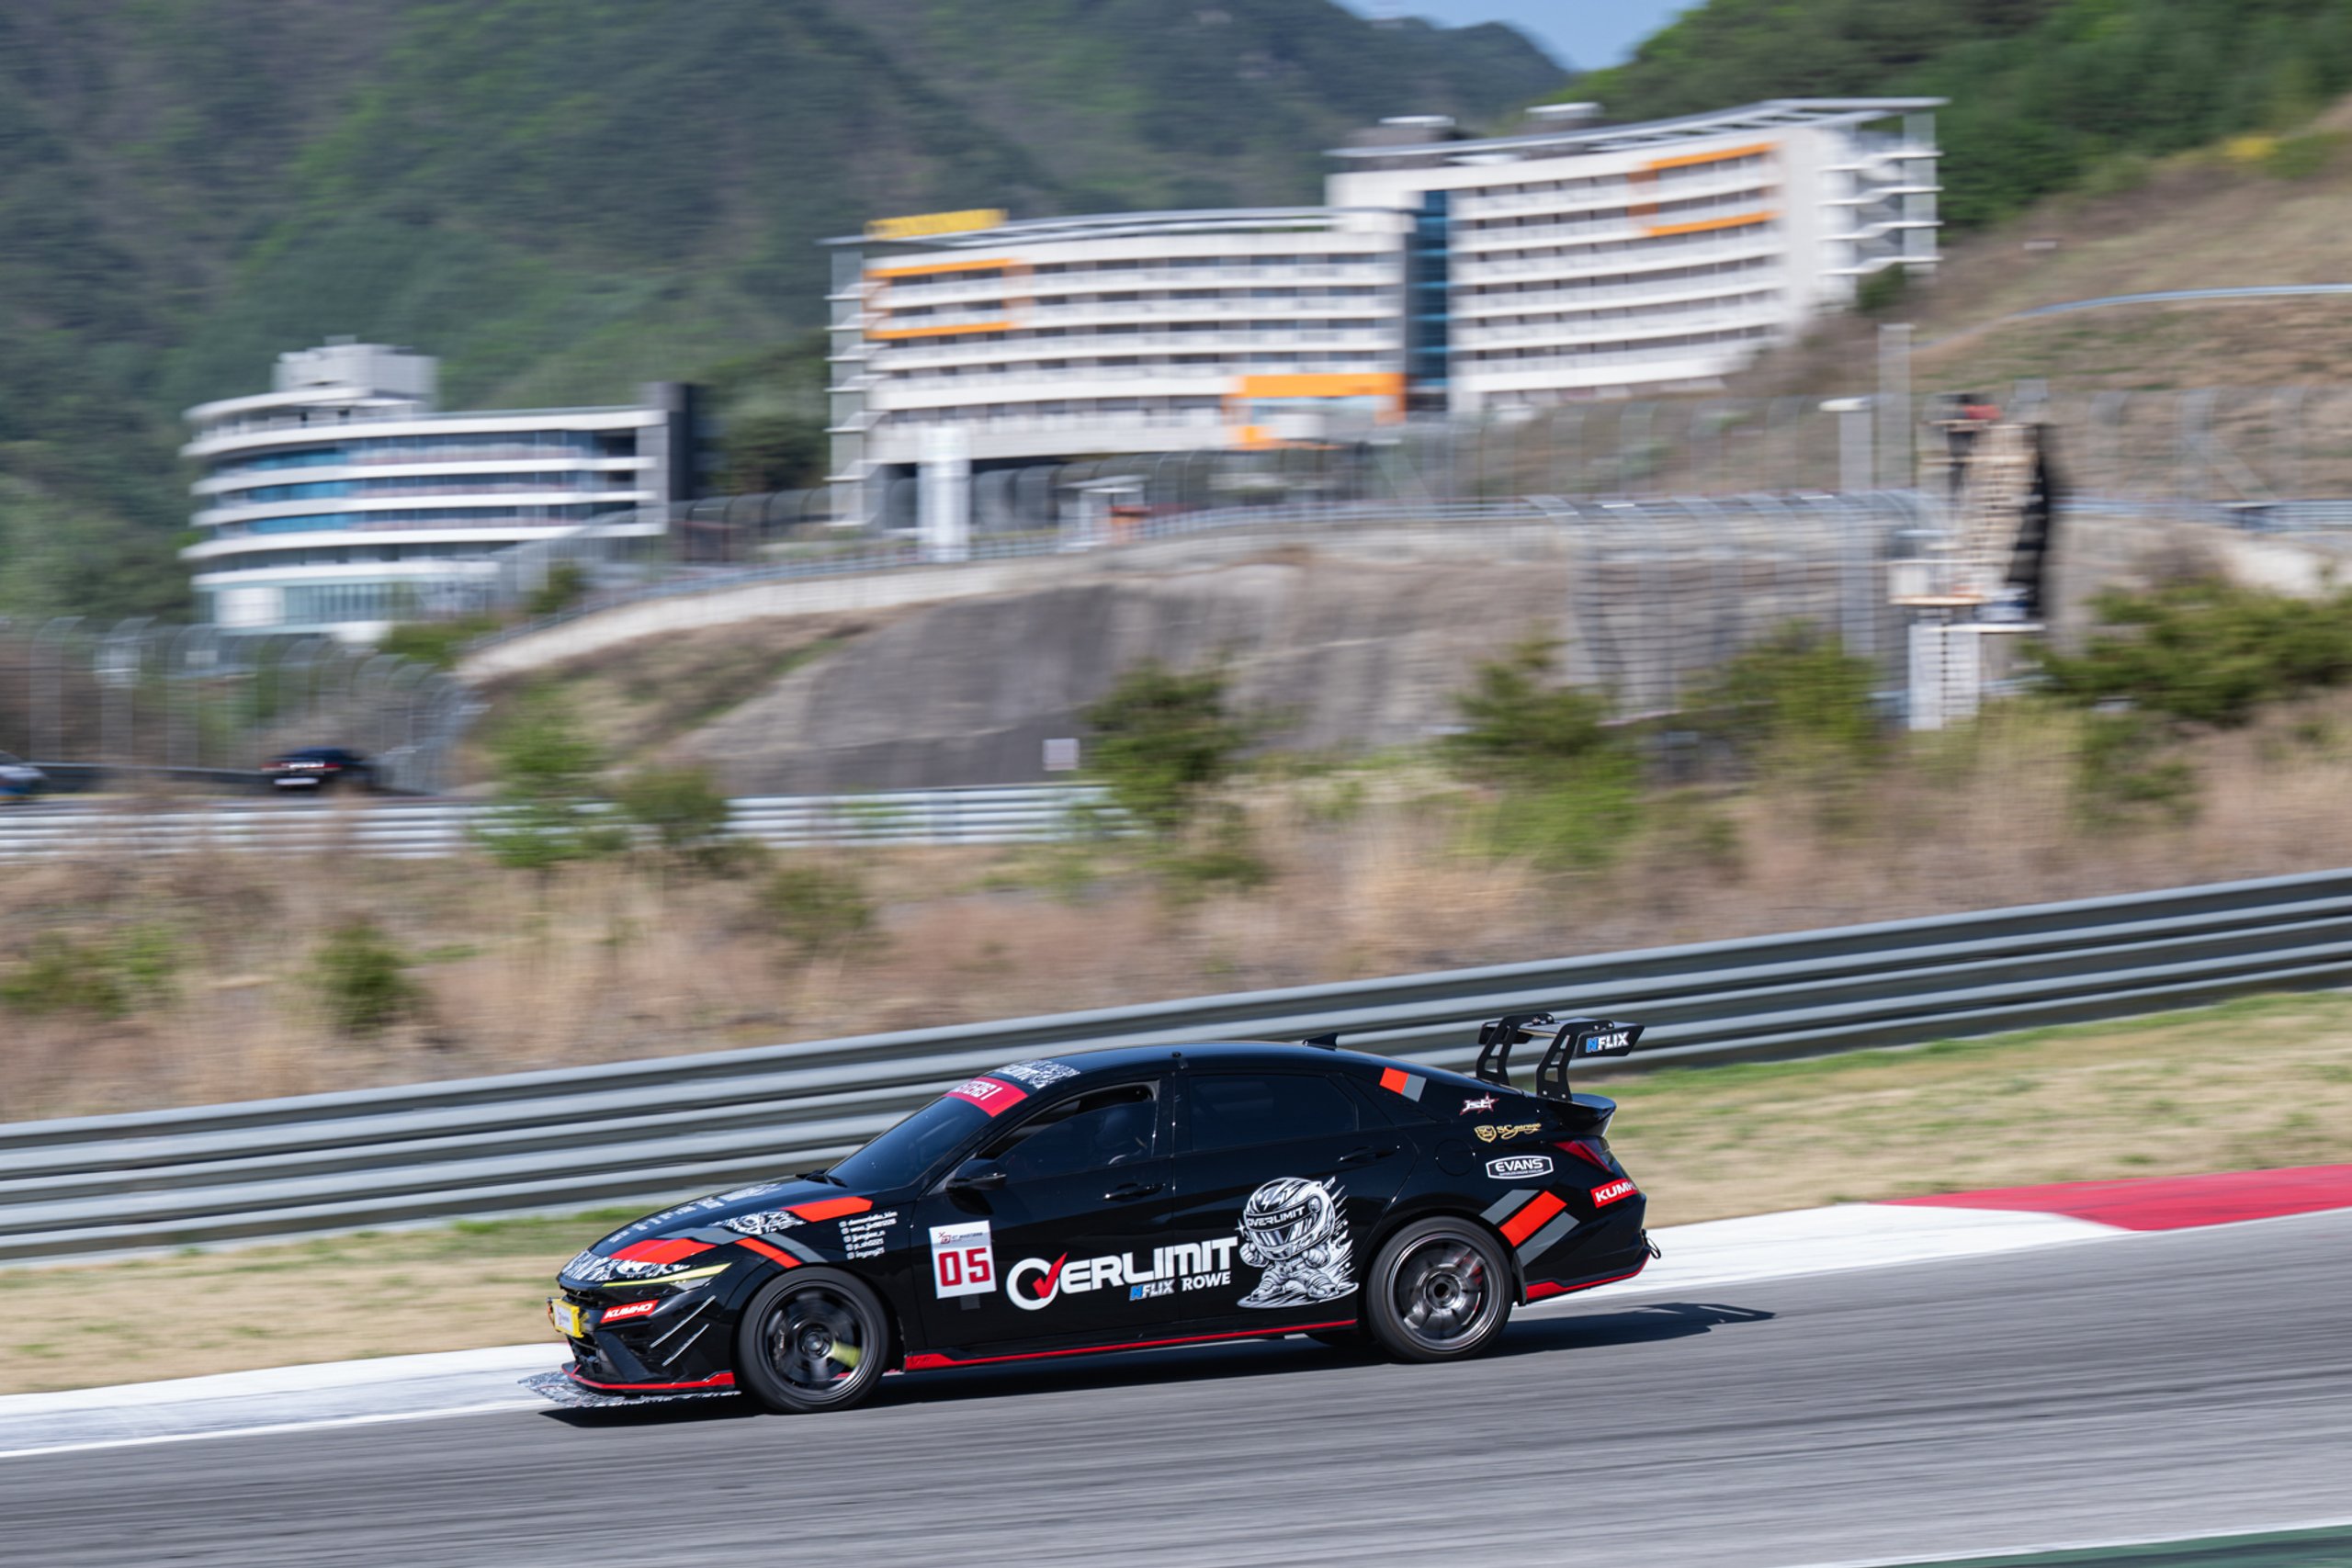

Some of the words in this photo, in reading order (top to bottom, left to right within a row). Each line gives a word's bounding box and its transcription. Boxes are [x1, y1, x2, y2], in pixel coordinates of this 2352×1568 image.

[1586, 1031, 1630, 1054] NFLIX
[1495, 1158, 1544, 1172] EVANS
[1248, 1206, 1306, 1227] OVERLIMIT
[938, 1247, 991, 1287] 05
[1182, 1270, 1232, 1292] ROWE
[604, 1303, 654, 1319] KUMHO
